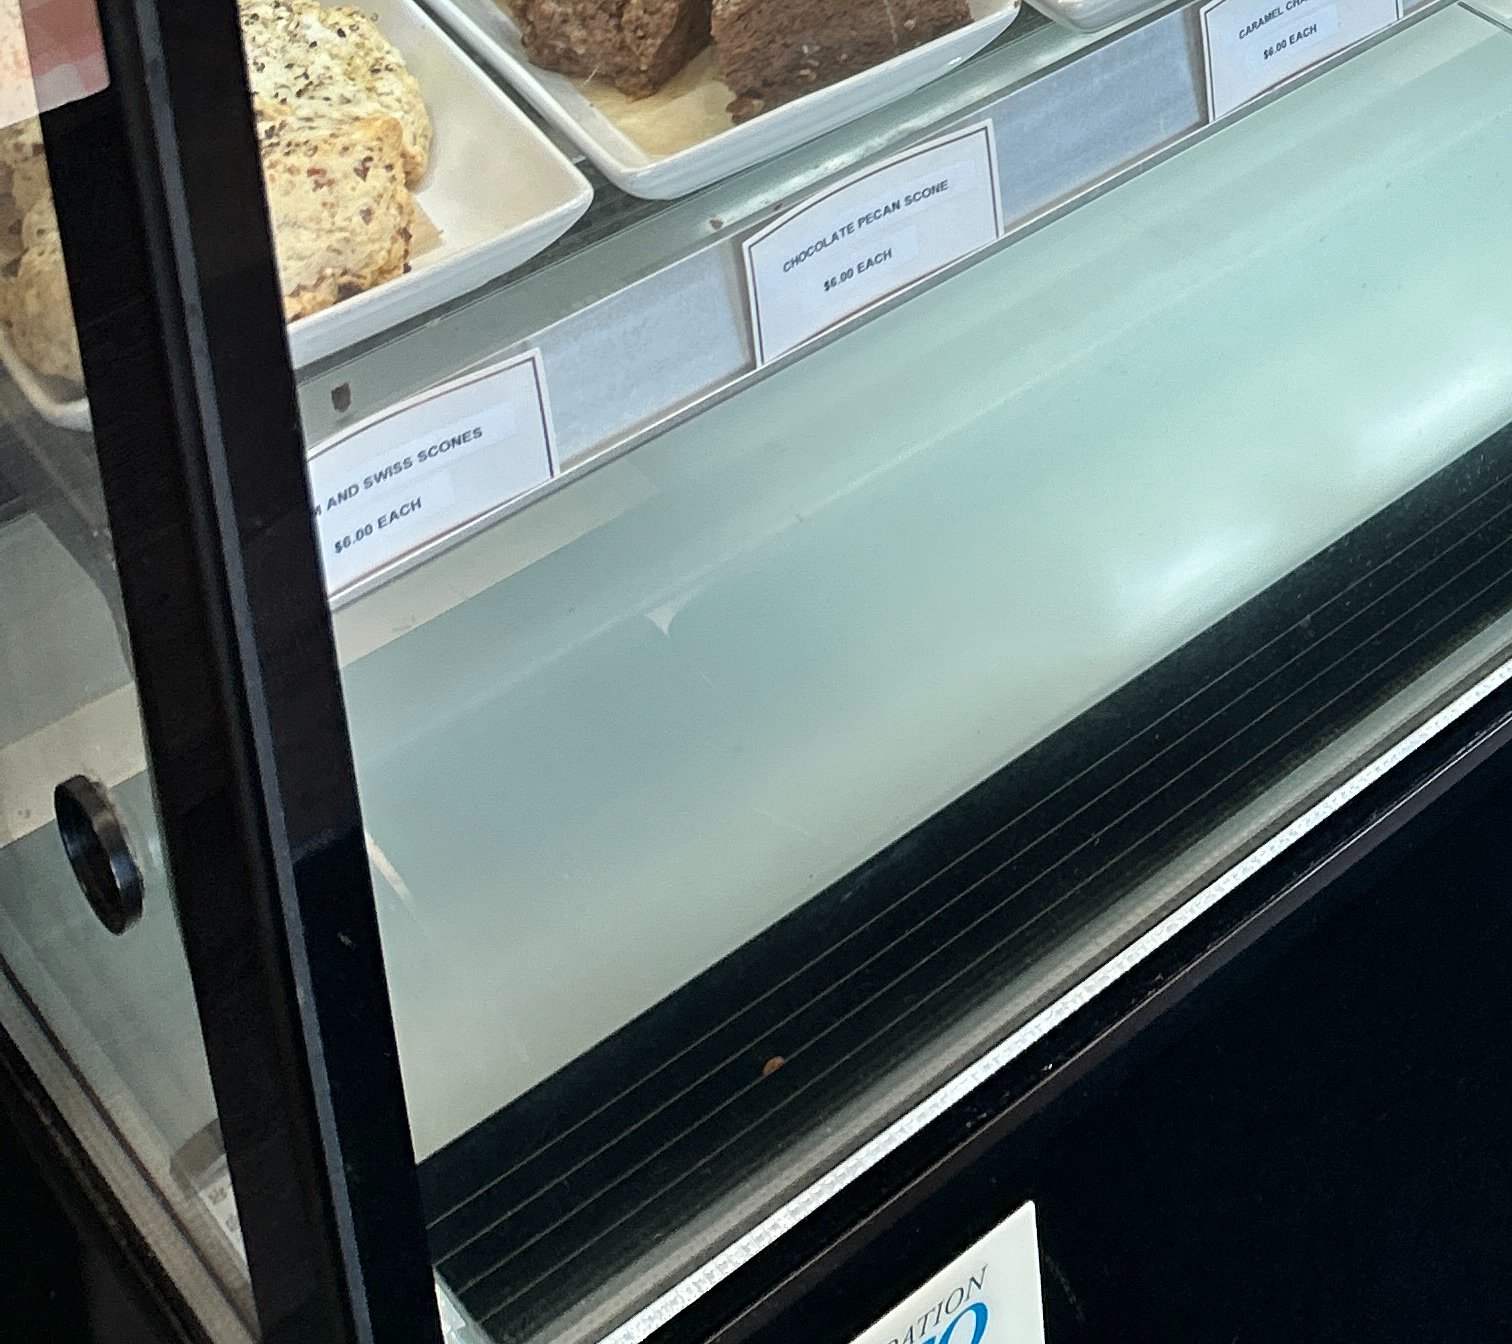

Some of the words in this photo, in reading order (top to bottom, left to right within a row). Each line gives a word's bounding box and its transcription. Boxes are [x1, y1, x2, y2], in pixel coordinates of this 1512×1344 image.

[1238, 7, 1284, 40] CARAMEL
[1263, 39, 1287, 60] $6.00
[1289, 23, 1317, 45] EACH
[783, 222, 855, 273] CHOCOLATE
[857, 199, 901, 229] PECAN
[904, 179, 949, 207] SCONE
[823, 268, 854, 292] $6.00
[857, 247, 892, 274] EACH
[326, 483, 360, 511] AND
[363, 456, 413, 490] SWISS
[417, 427, 483, 463] SCONES
[334, 523, 373, 554] $6.00
[377, 497, 422, 529] EACH
